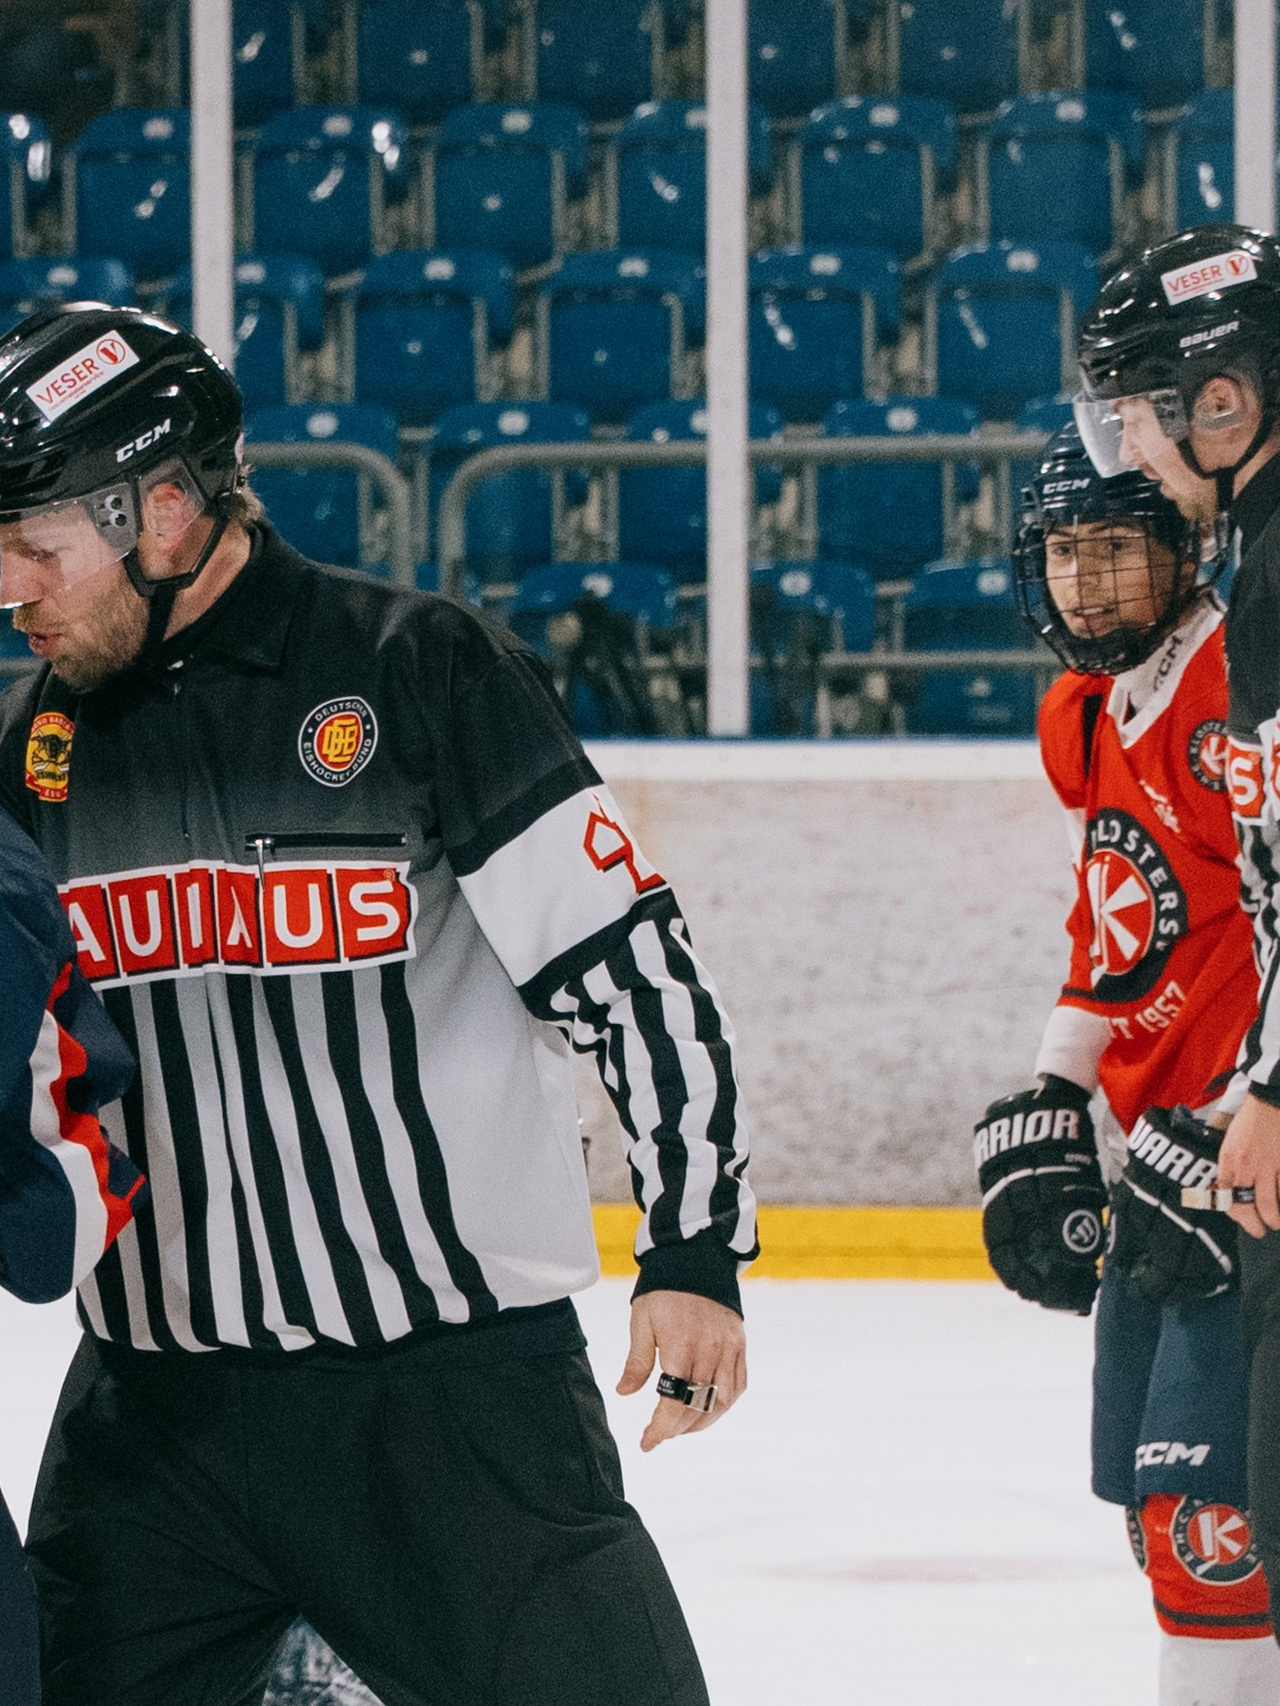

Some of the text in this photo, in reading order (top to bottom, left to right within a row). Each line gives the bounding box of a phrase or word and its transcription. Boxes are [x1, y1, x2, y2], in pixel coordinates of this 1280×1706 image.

[1168, 264, 1222, 292] VESER
[36, 357, 100, 405] VESER
[115, 418, 171, 463] CCM
[1042, 478, 1091, 495] CCM
[1135, 1442, 1211, 1471] CCM
